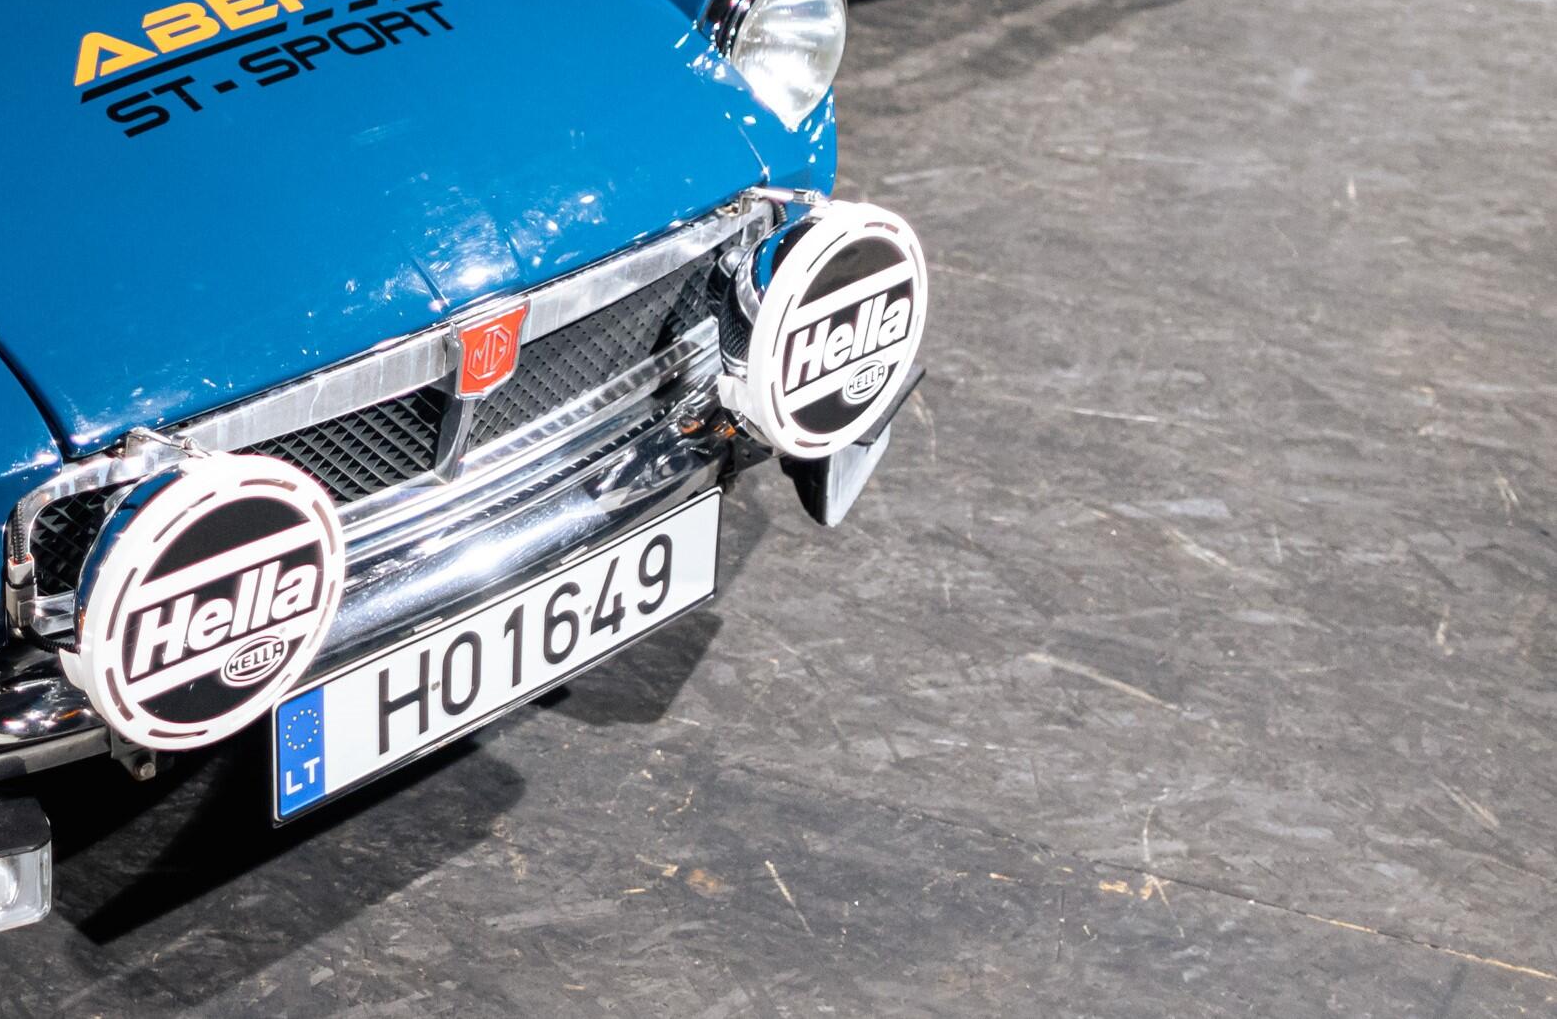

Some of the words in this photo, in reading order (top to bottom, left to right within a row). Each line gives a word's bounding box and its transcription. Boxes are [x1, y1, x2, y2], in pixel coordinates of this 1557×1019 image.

[472, 328, 509, 375] MG
[785, 292, 911, 393] Hella
[848, 365, 886, 392] HELLA
[129, 559, 318, 680] Hella
[228, 641, 285, 674] HELLA
[284, 756, 321, 797] LT
